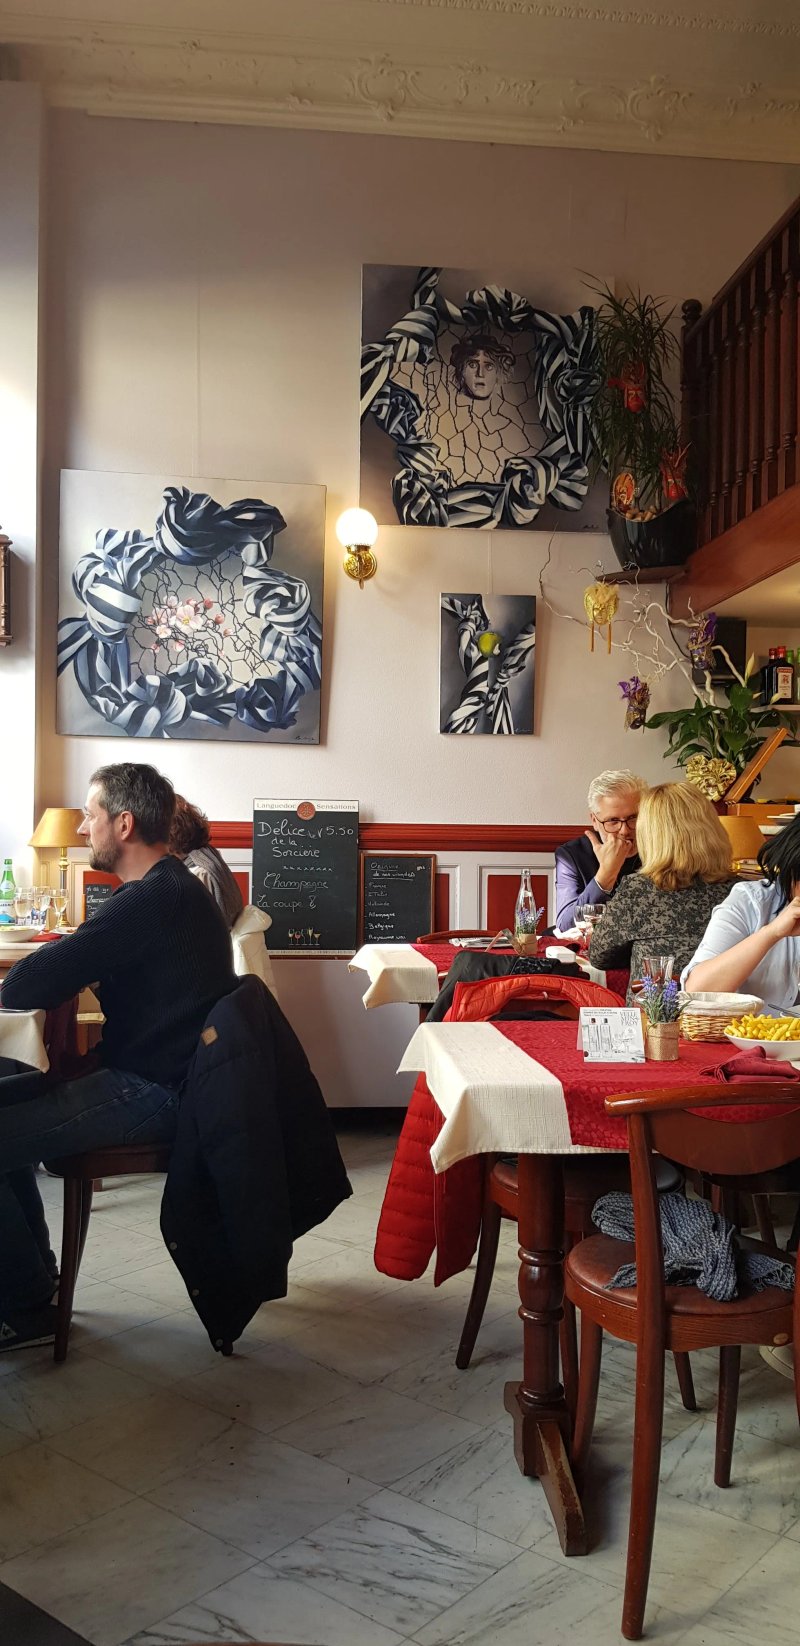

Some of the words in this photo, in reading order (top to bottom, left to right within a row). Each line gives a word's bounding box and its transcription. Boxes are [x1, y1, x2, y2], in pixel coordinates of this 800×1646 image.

[257, 818, 306, 837] Délice
[271, 836, 287, 845] de
[288, 836, 298, 847] la
[263, 872, 329, 892] Champagne
[273, 900, 303, 912] coupe
